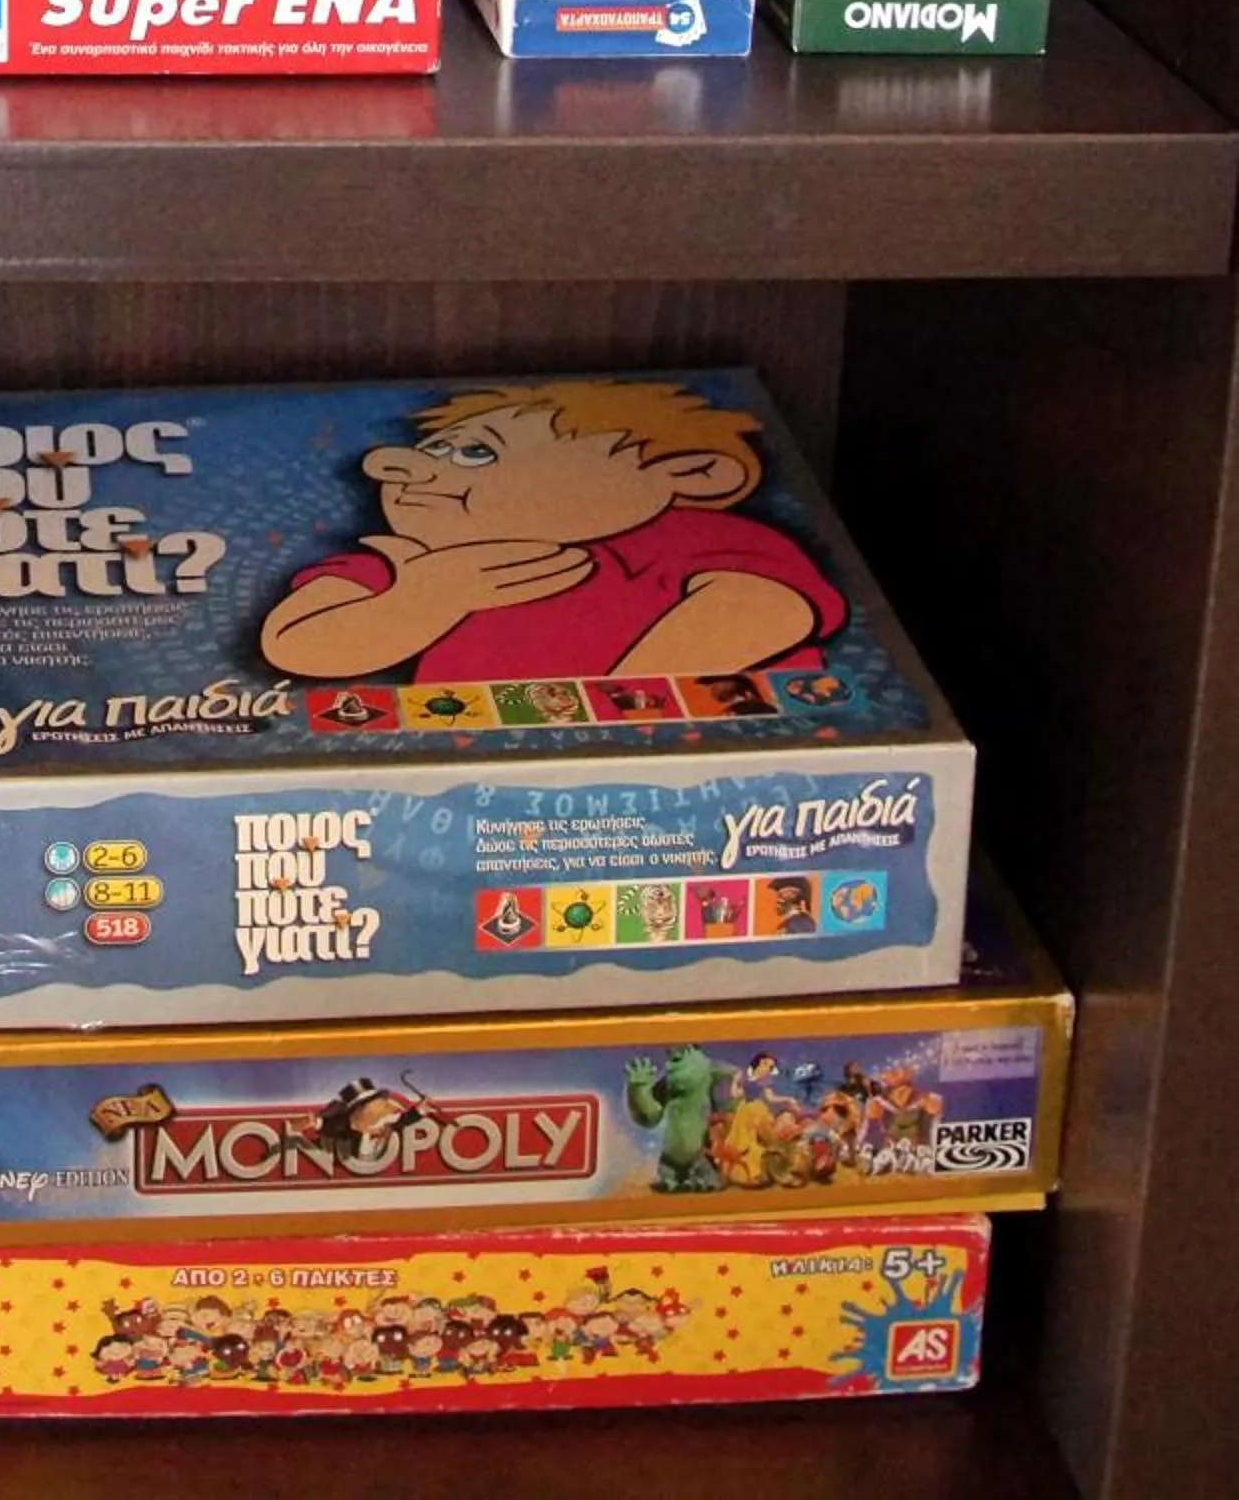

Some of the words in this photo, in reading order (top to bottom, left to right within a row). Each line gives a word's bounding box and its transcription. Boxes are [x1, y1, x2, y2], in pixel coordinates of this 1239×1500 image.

[844, 1, 998, 44] MODIANO
[92, 846, 138, 867] 2-6
[94, 882, 152, 902] 8-11
[96, 919, 139, 938] 518
[937, 1122, 1027, 1145] PARKER
[882, 1248, 947, 1280] 5+
[172, 1268, 226, 1287] ΑΠΟ
[233, 1269, 248, 1286] 2
[269, 1269, 285, 1287] 6
[291, 1269, 397, 1288] ΠΑΙΚΤΕΣ
[896, 1327, 950, 1364] AS
